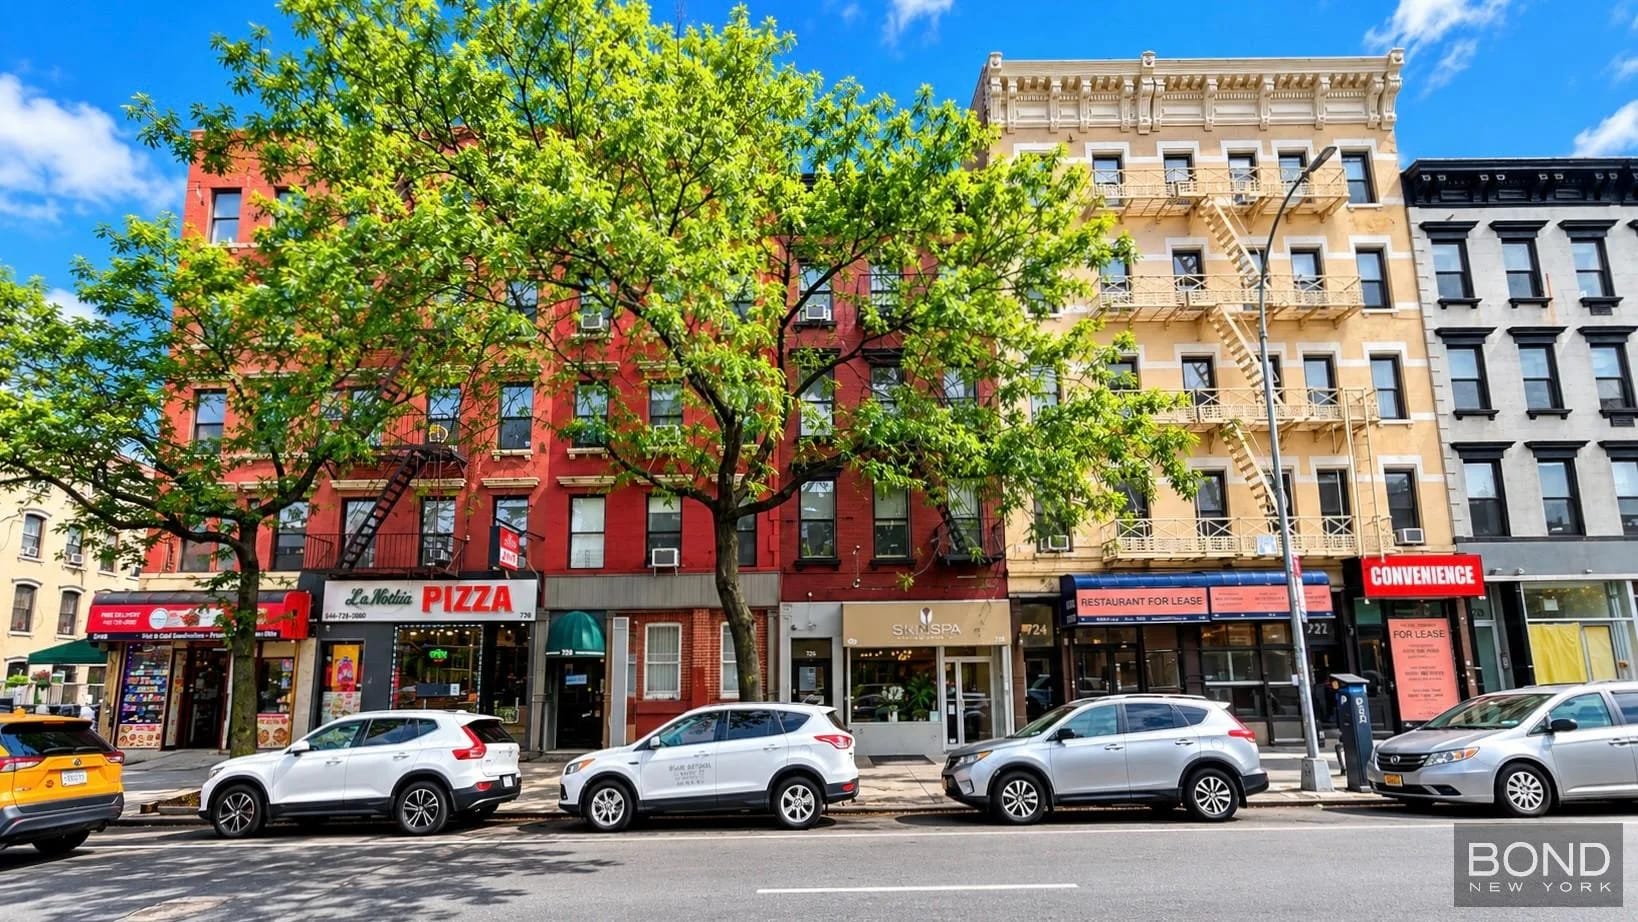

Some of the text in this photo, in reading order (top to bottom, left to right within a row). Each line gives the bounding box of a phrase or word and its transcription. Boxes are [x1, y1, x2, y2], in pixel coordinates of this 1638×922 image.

[1370, 565, 1475, 586] CONVENIENCE
[345, 588, 369, 606] La
[422, 584, 514, 613] PIZZA
[1081, 596, 1203, 607] RESTAURANT FOR LEASE
[1026, 623, 1048, 636] 724
[1306, 622, 1328, 635] 722
[1393, 629, 1446, 639] FOR LEASE
